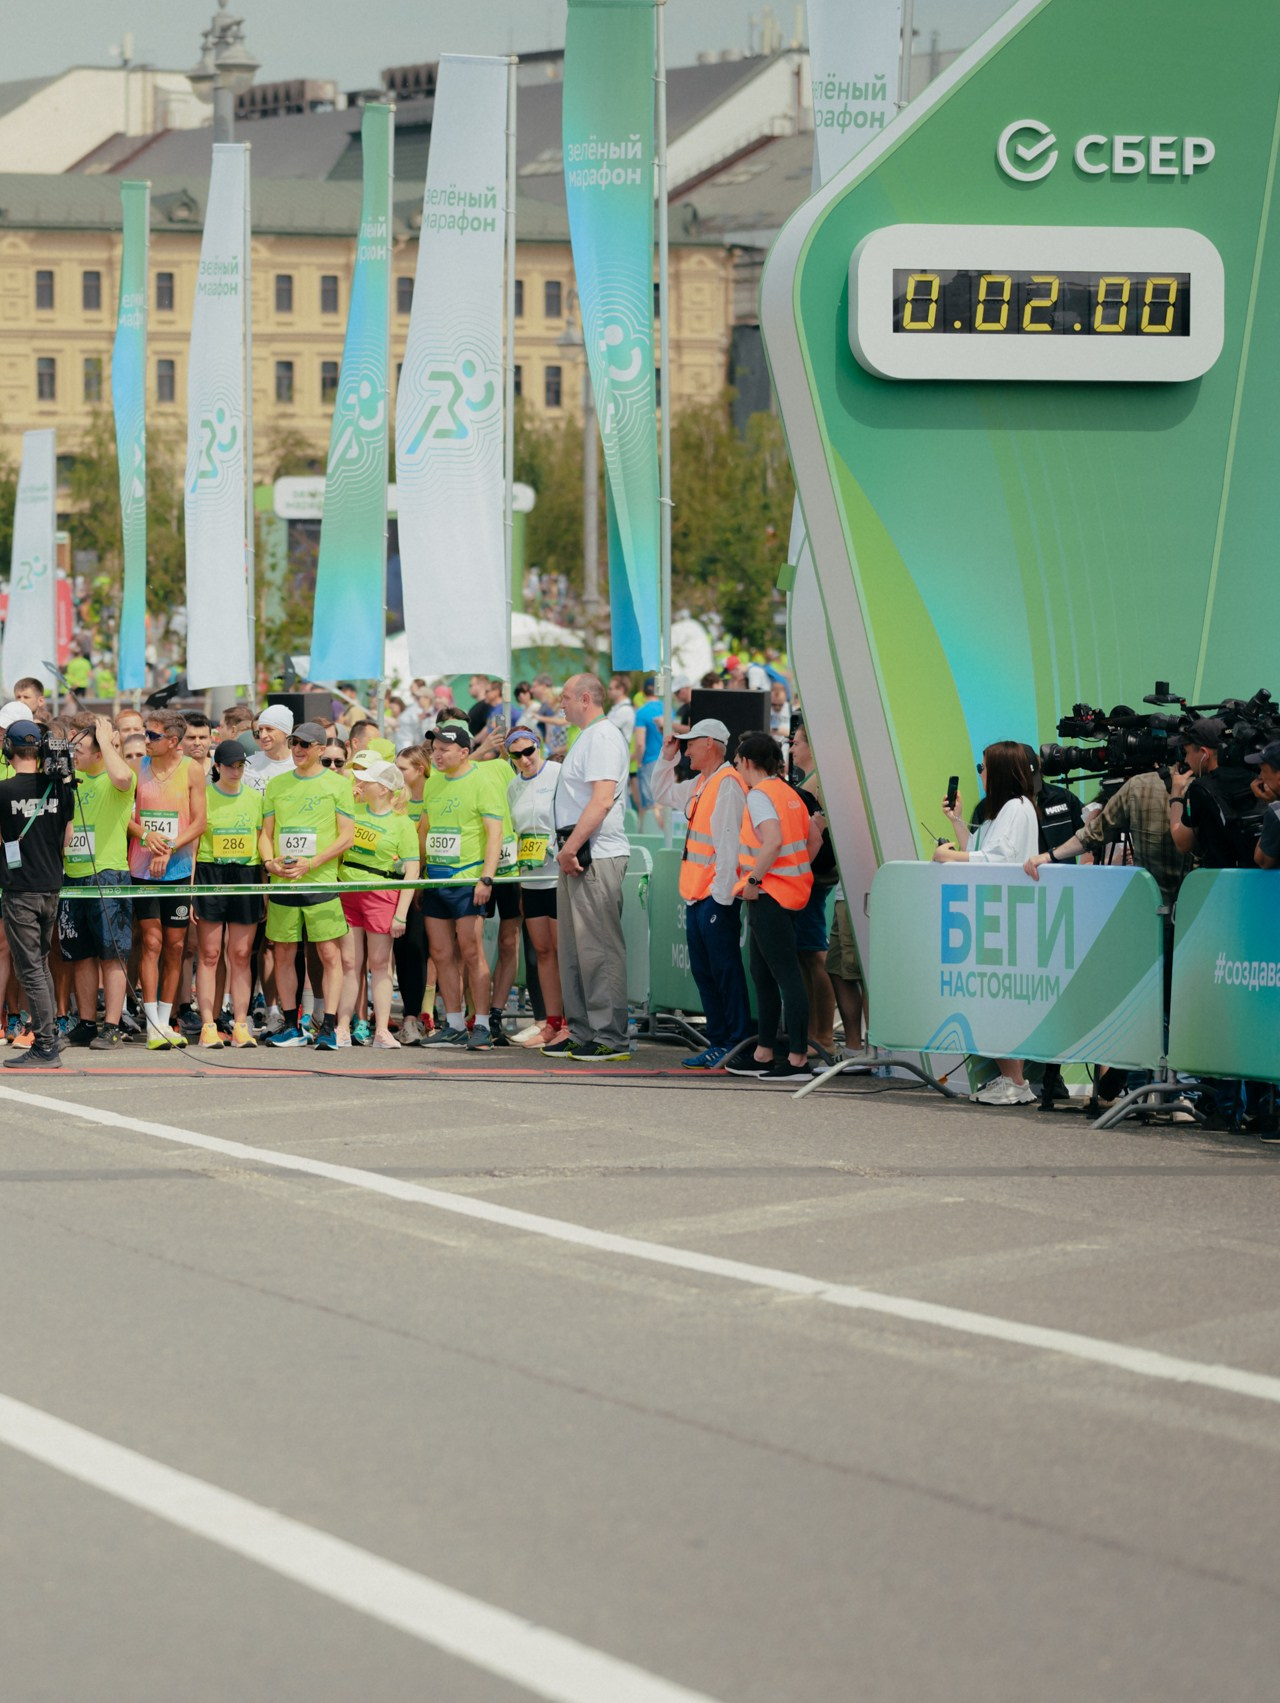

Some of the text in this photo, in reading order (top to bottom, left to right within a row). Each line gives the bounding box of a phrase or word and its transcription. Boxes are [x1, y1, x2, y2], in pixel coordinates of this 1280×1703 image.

[568, 134, 642, 161] зелёный
[1074, 134, 1216, 175] СБЕР
[568, 161, 641, 191] марафон
[144, 820, 172, 833] 5541
[222, 838, 245, 850] 286
[285, 837, 307, 848] 637
[430, 836, 456, 848] 3507
[941, 884, 1075, 970] БЕГИ
[940, 970, 1060, 1005] НАСТОЯЩИМ
